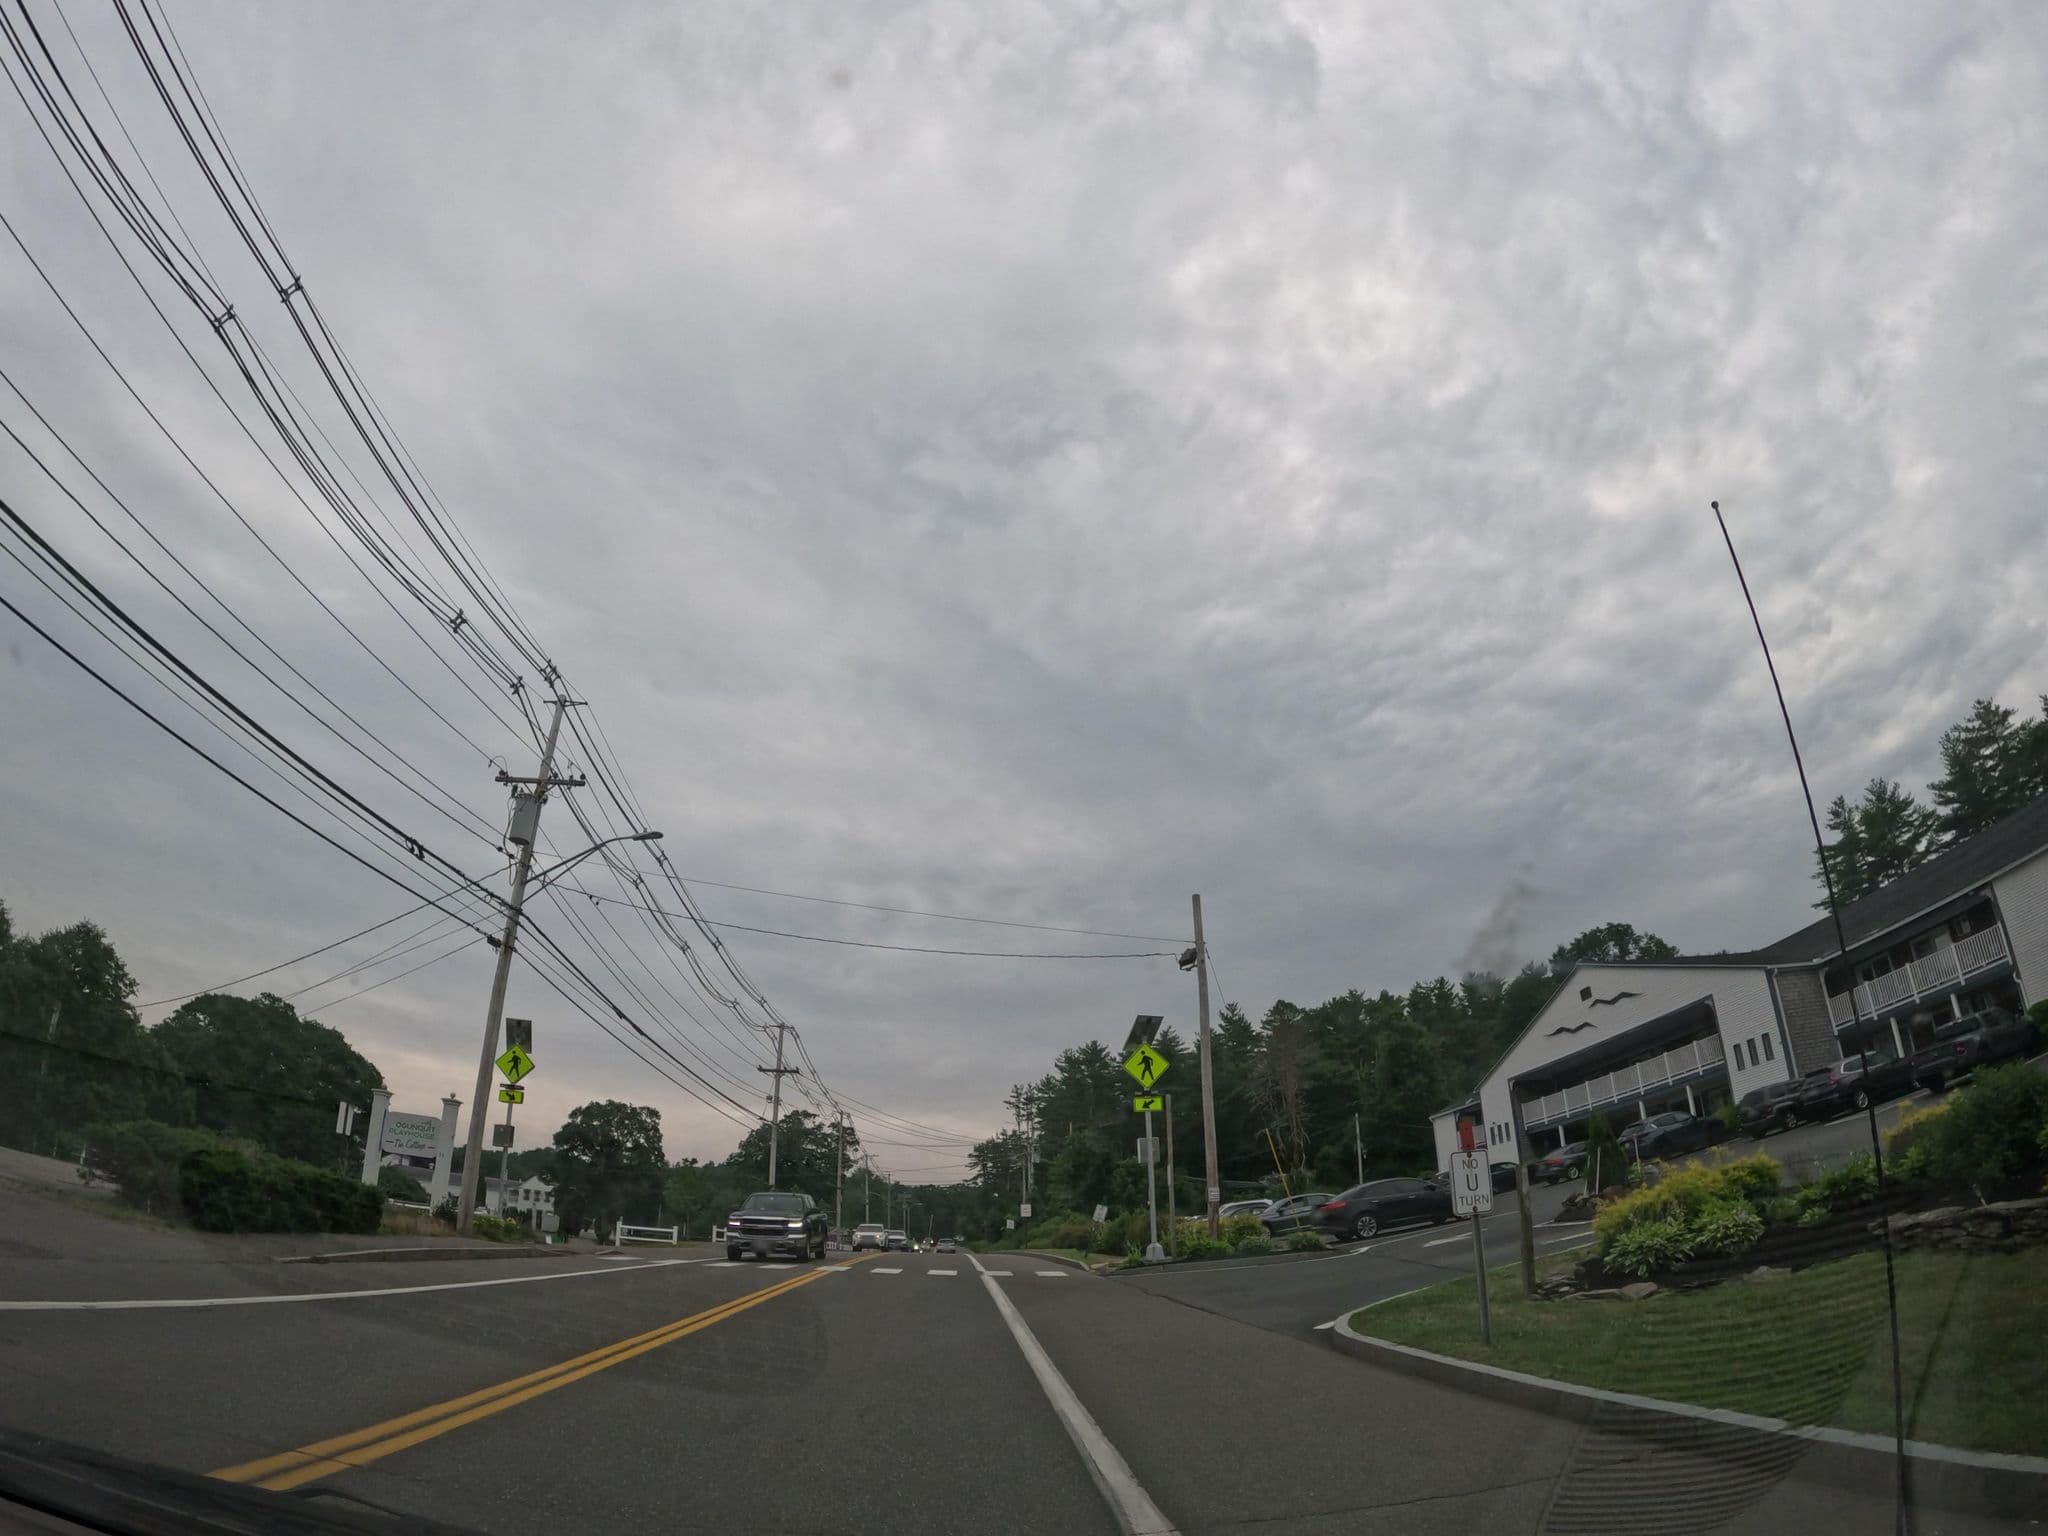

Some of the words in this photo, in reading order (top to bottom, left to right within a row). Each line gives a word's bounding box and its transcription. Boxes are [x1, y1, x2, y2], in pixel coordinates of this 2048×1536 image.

[1462, 1159, 1478, 1169] NO
[1466, 1173, 1478, 1191] U
[1459, 1195, 1489, 1206] TURN
